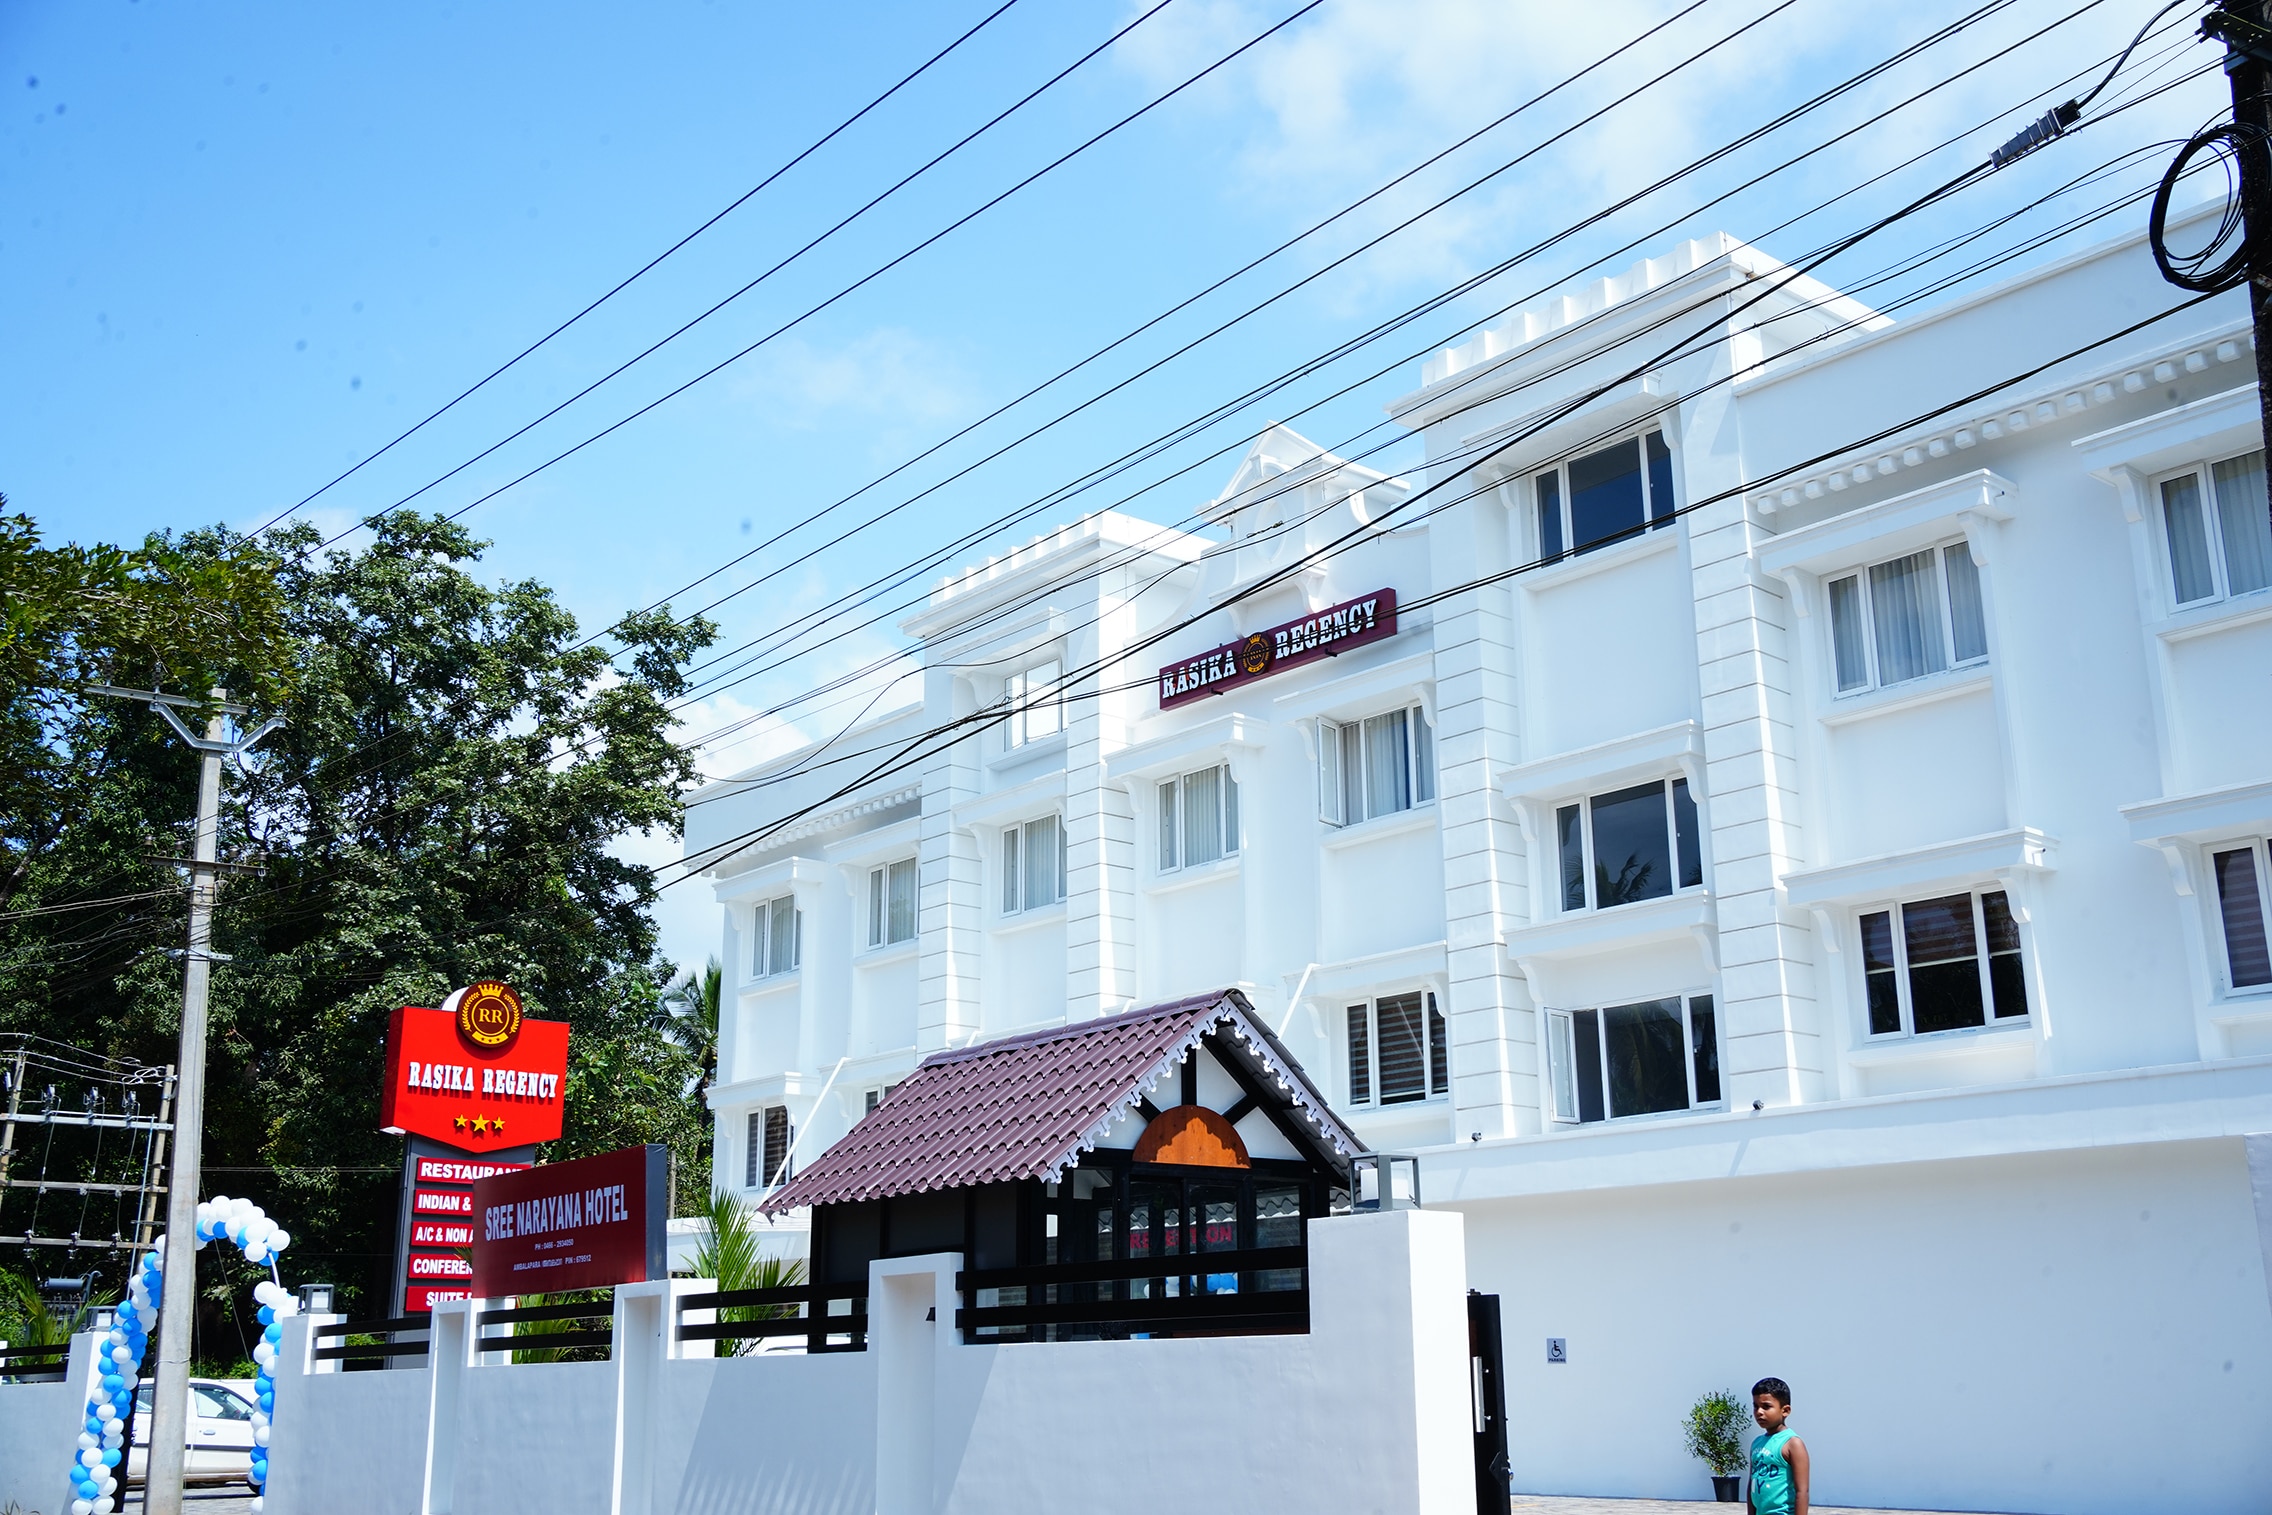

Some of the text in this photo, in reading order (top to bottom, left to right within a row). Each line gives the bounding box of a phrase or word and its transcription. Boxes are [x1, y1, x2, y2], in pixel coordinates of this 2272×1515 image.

[1162, 650, 1237, 698] RASIKA
[1275, 599, 1377, 659] REGENCY
[479, 1008, 503, 1023] RR
[408, 1061, 558, 1098] RASIKA REGENCY
[420, 1161, 523, 1180] RESTAURA
[418, 1194, 471, 1211] INDIAN &
[485, 1184, 628, 1241] SREE NARAYANA HOTEL
[415, 1226, 434, 1241] A/C
[435, 1227, 443, 1242] &
[445, 1227, 467, 1243] NON
[1129, 1225, 1233, 1249] REETON
